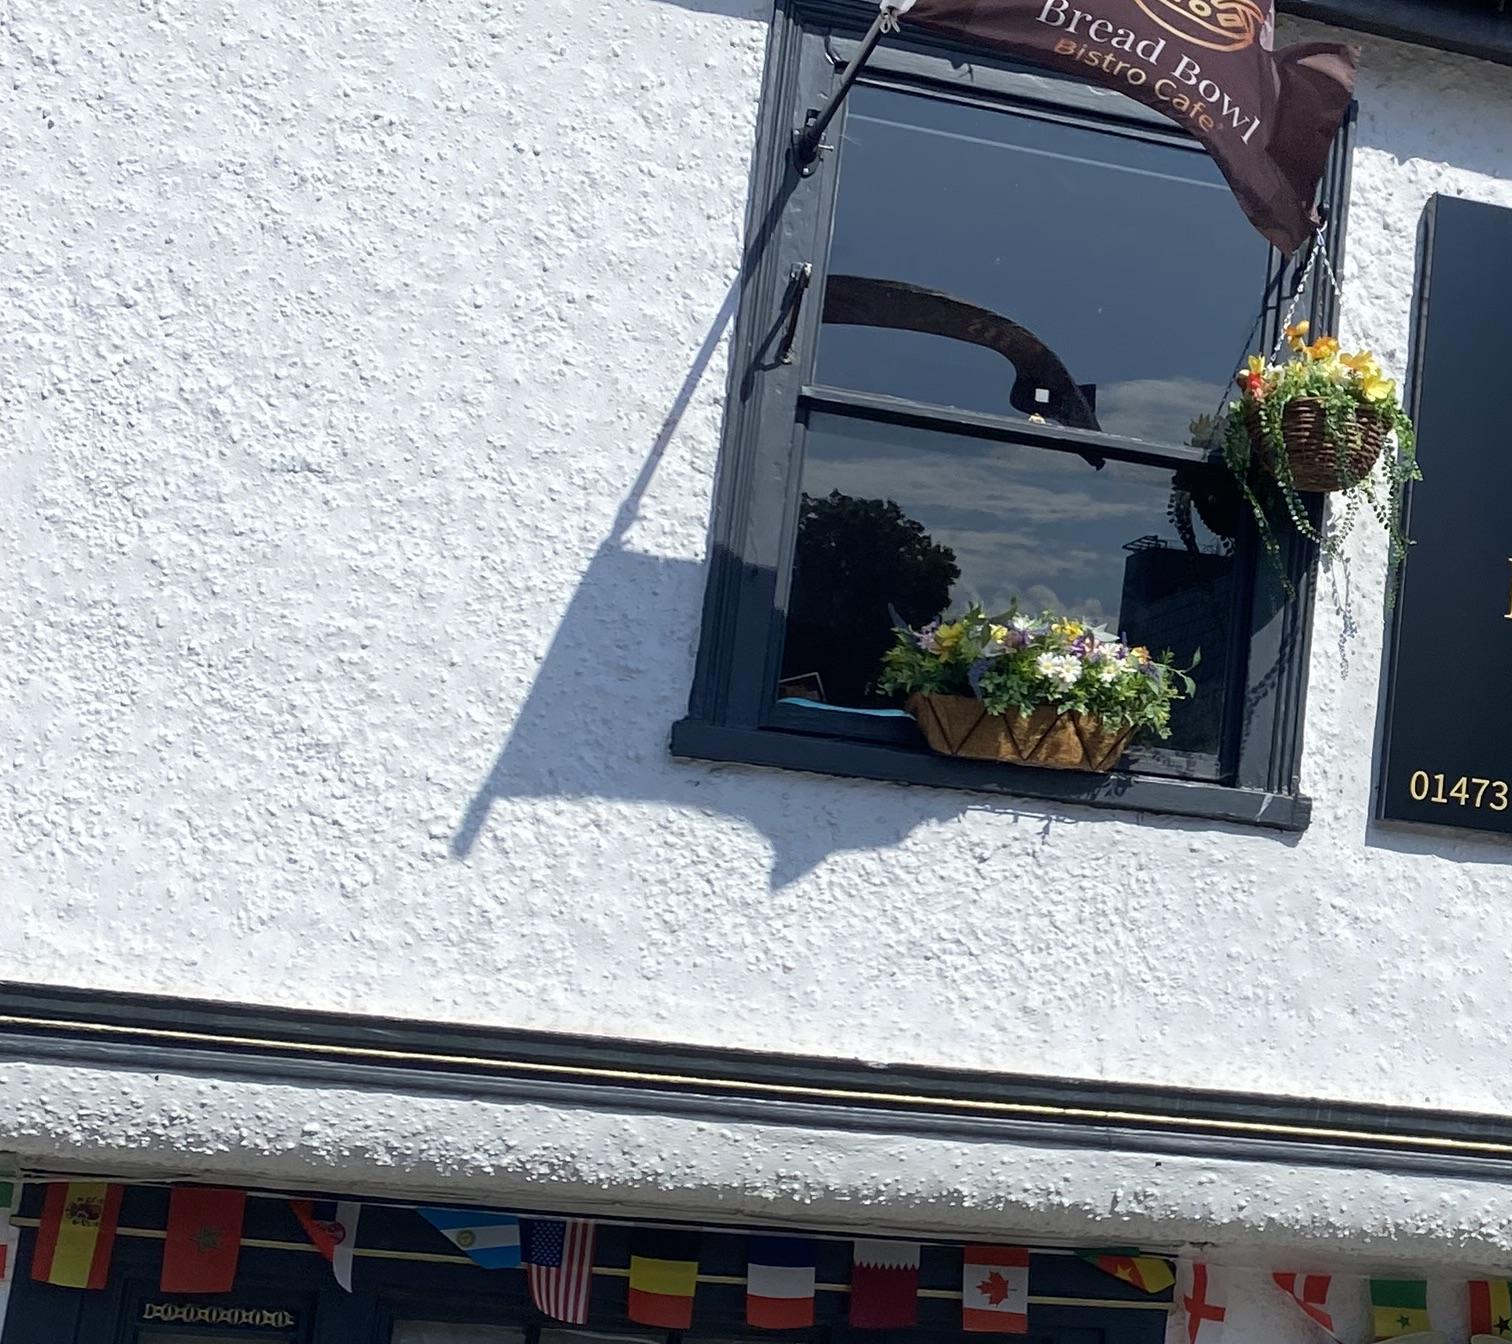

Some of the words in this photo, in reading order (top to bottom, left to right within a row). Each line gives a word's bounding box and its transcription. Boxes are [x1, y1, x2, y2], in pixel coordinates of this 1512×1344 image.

[1053, 38, 1149, 87] Bistro
[1171, 53, 1263, 146] Bowl
[1409, 769, 1509, 813] 01473
